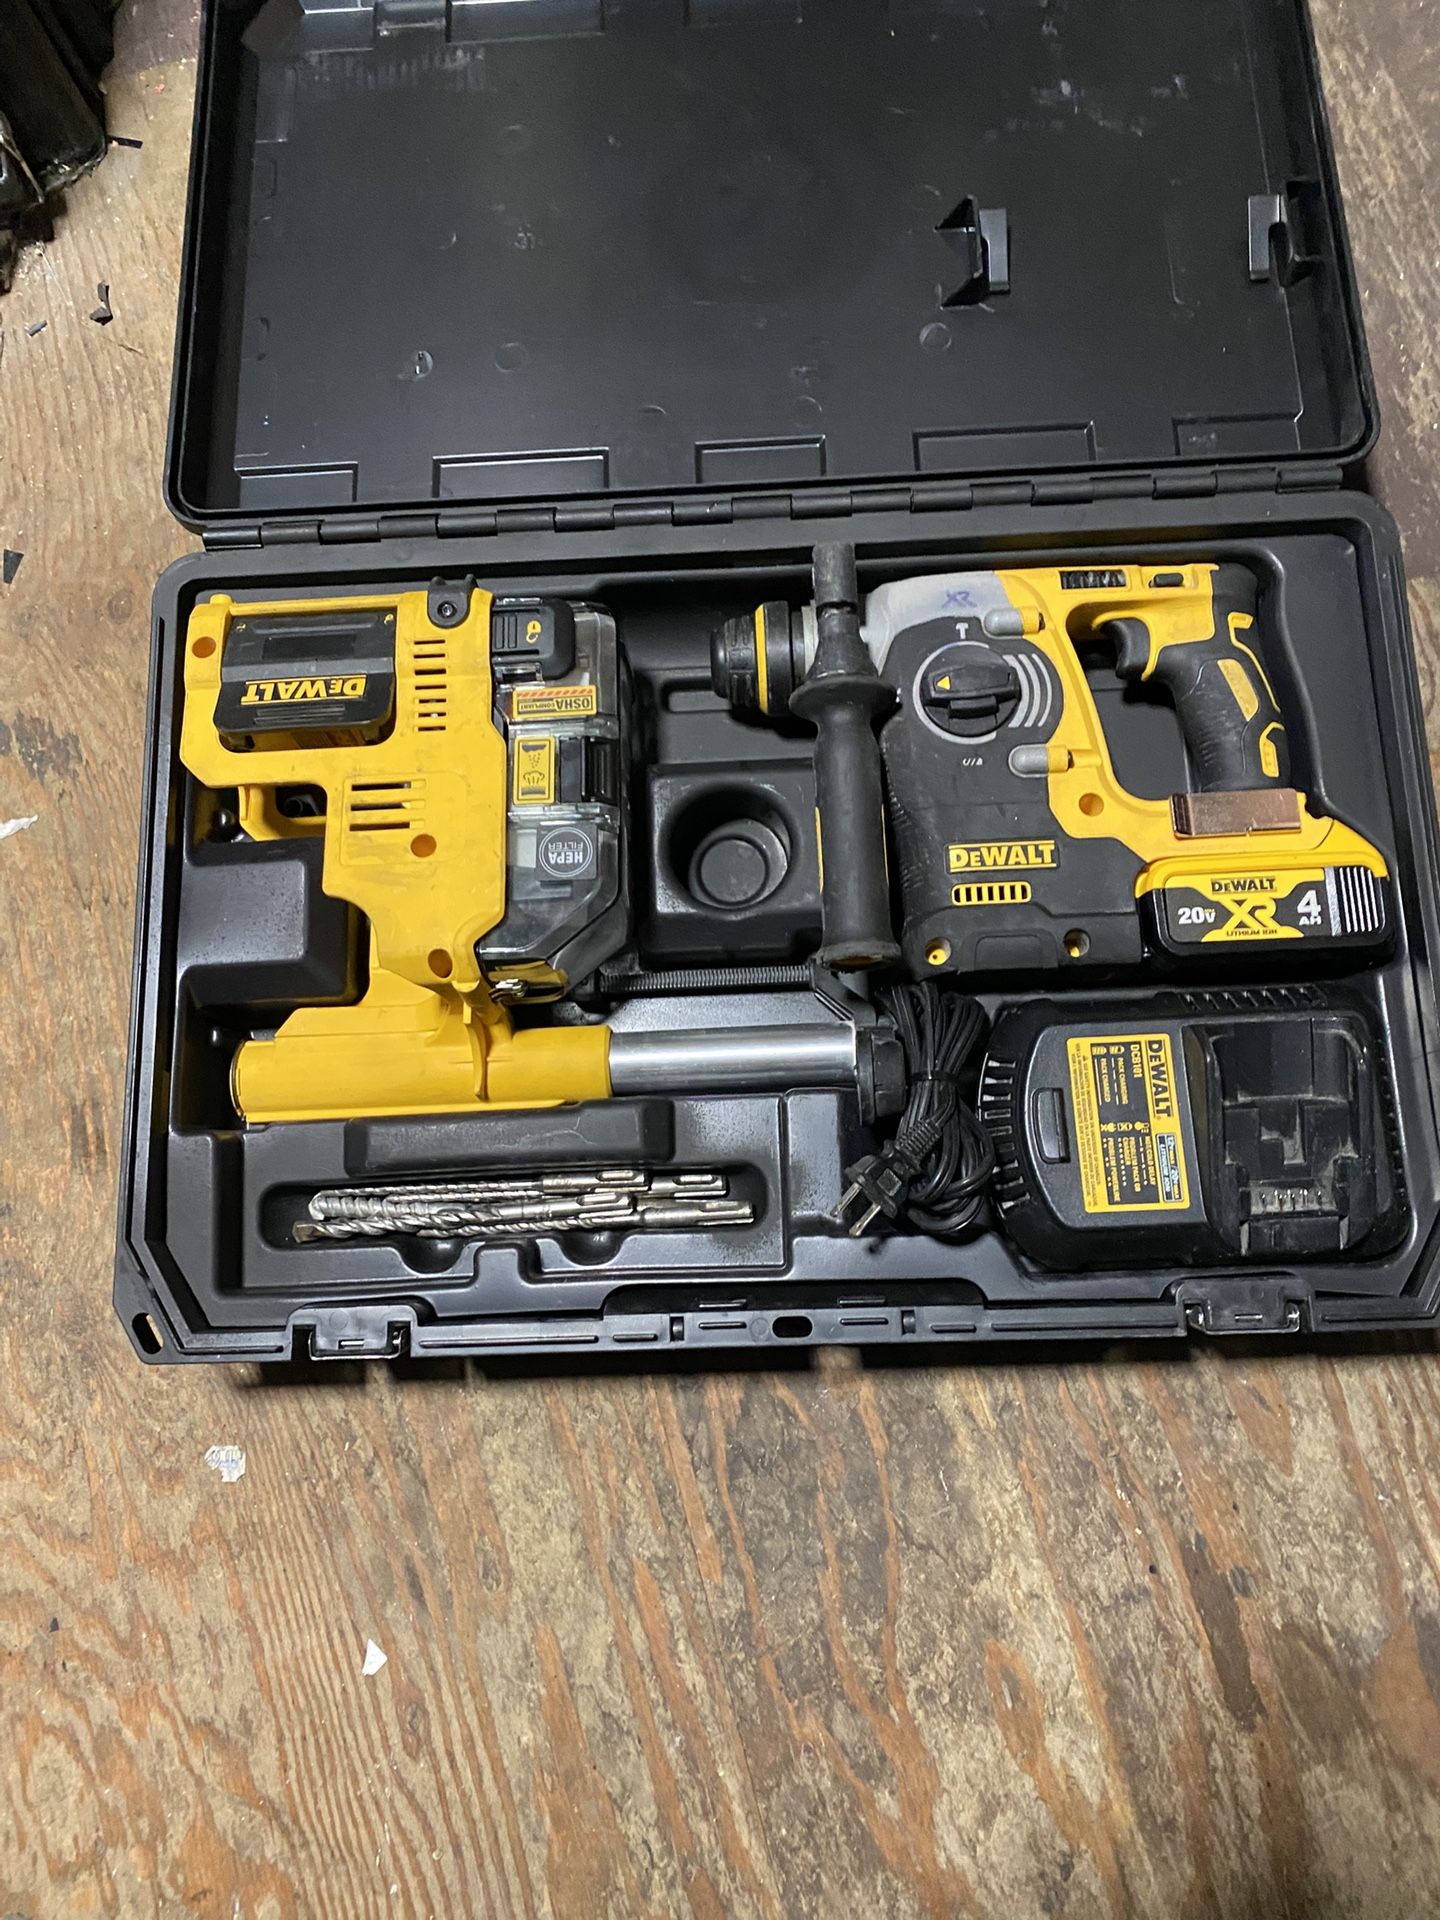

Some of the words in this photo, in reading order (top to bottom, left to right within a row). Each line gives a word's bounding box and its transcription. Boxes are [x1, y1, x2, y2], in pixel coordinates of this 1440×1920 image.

[240, 678, 366, 702] DEWALT
[520, 702, 554, 710] COMPLIANT
[556, 698, 589, 711] OSHA
[548, 841, 584, 850] FILTER
[548, 851, 583, 864] HEPA
[948, 843, 1056, 868] DEWALT
[1211, 878, 1276, 892] DEWALT
[1297, 890, 1322, 915] 4
[1178, 906, 1216, 924] 20V
[1219, 896, 1281, 931] XR
[1226, 929, 1261, 937] LITHIUM
[1131, 1044, 1142, 1078] DCB101
[1148, 1040, 1171, 1117] DEWALT
